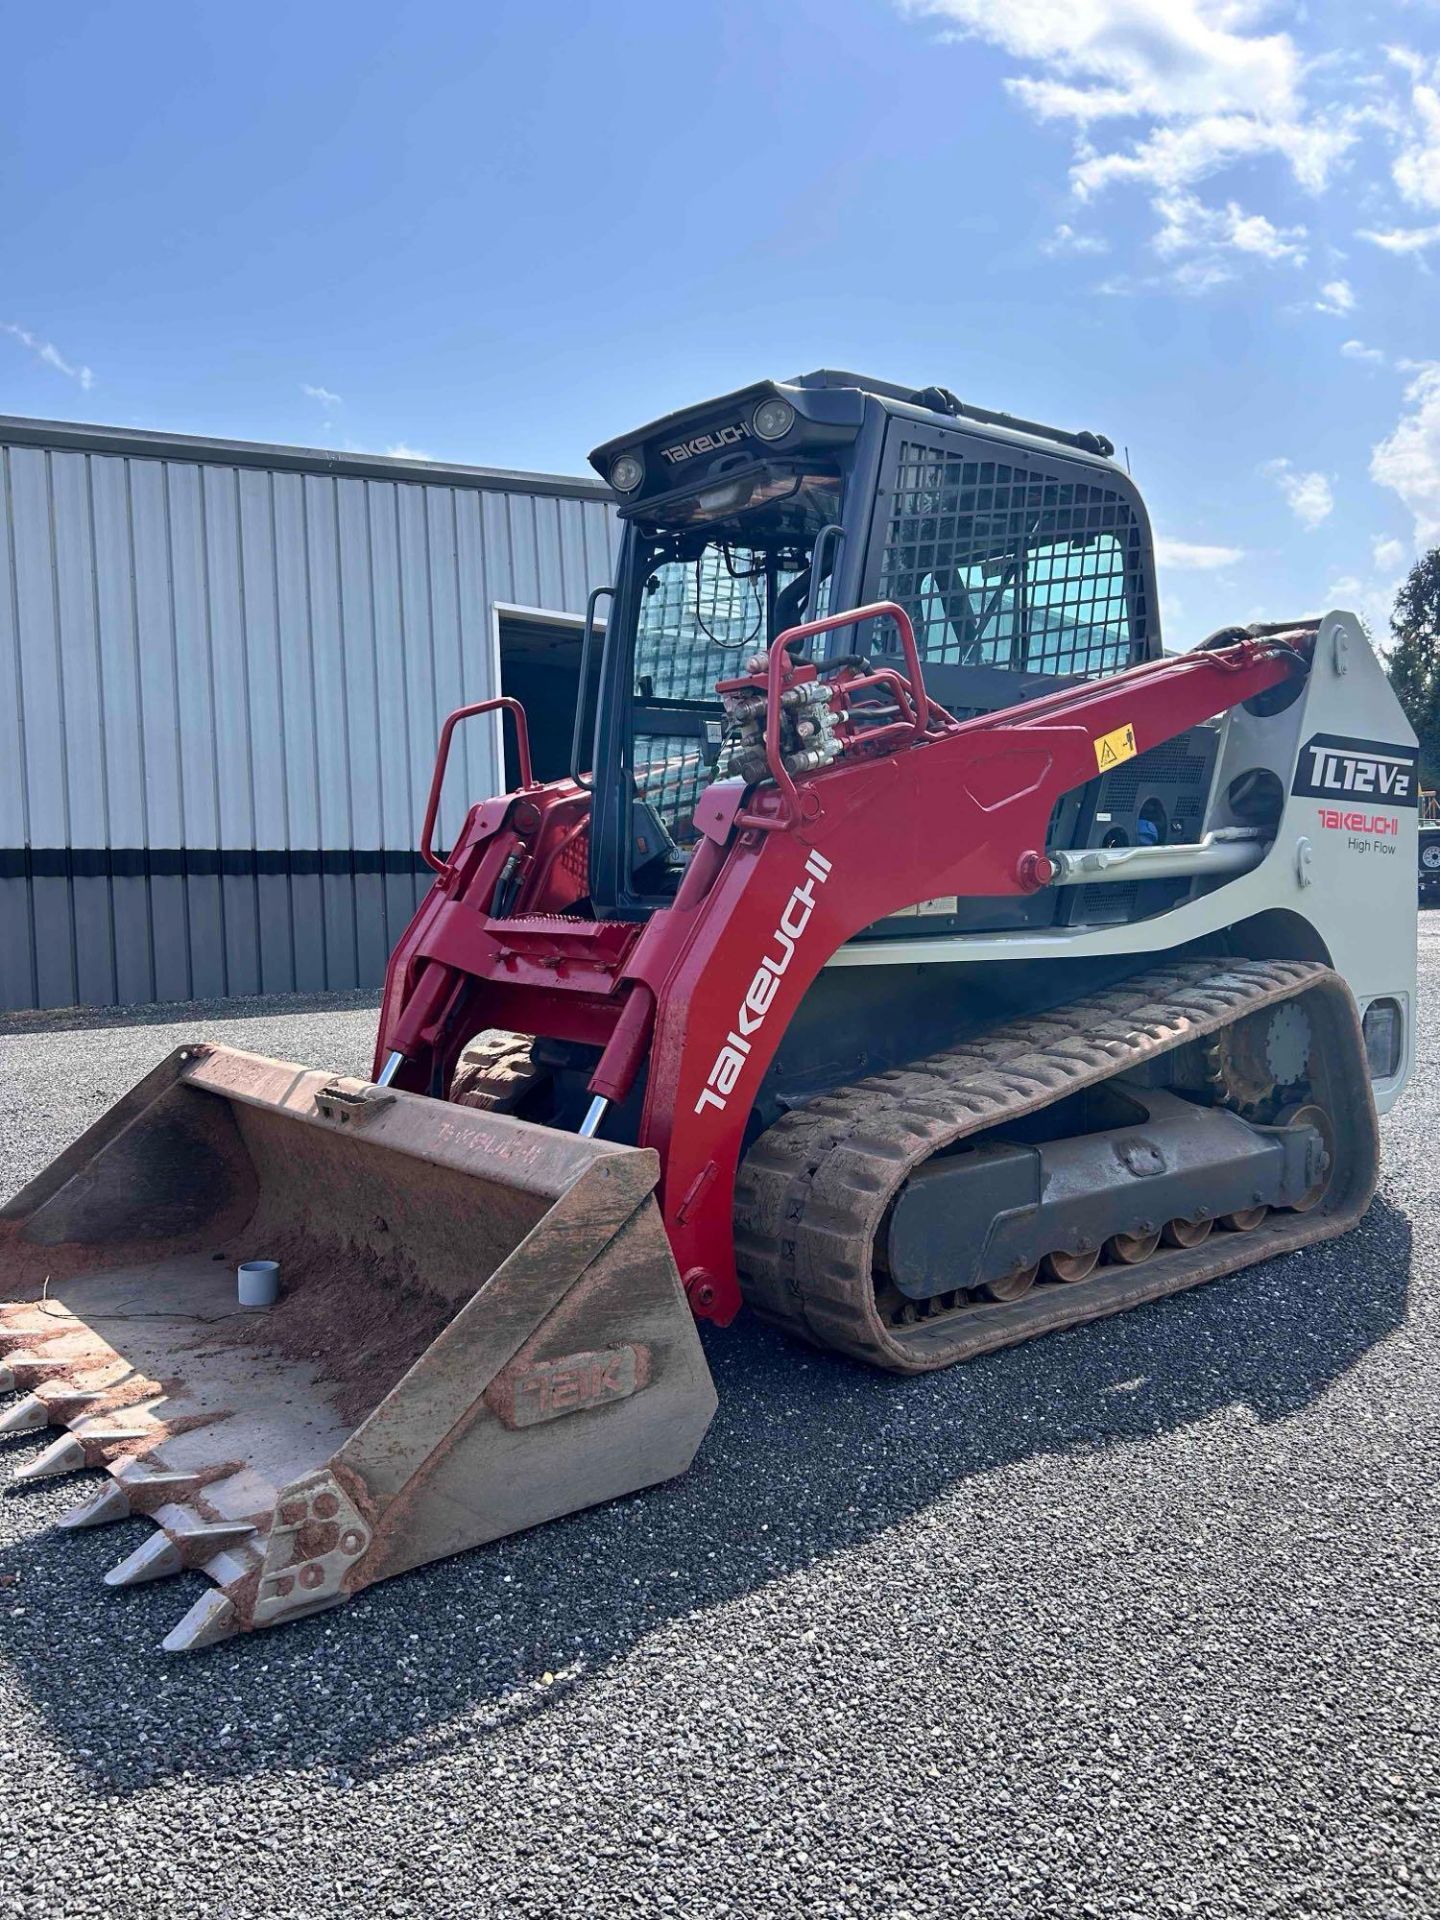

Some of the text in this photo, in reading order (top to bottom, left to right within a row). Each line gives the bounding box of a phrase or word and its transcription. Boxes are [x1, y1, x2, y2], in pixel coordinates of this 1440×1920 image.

[1309, 745, 1415, 796] TL12V2
[1347, 837, 1396, 855] High Flow
